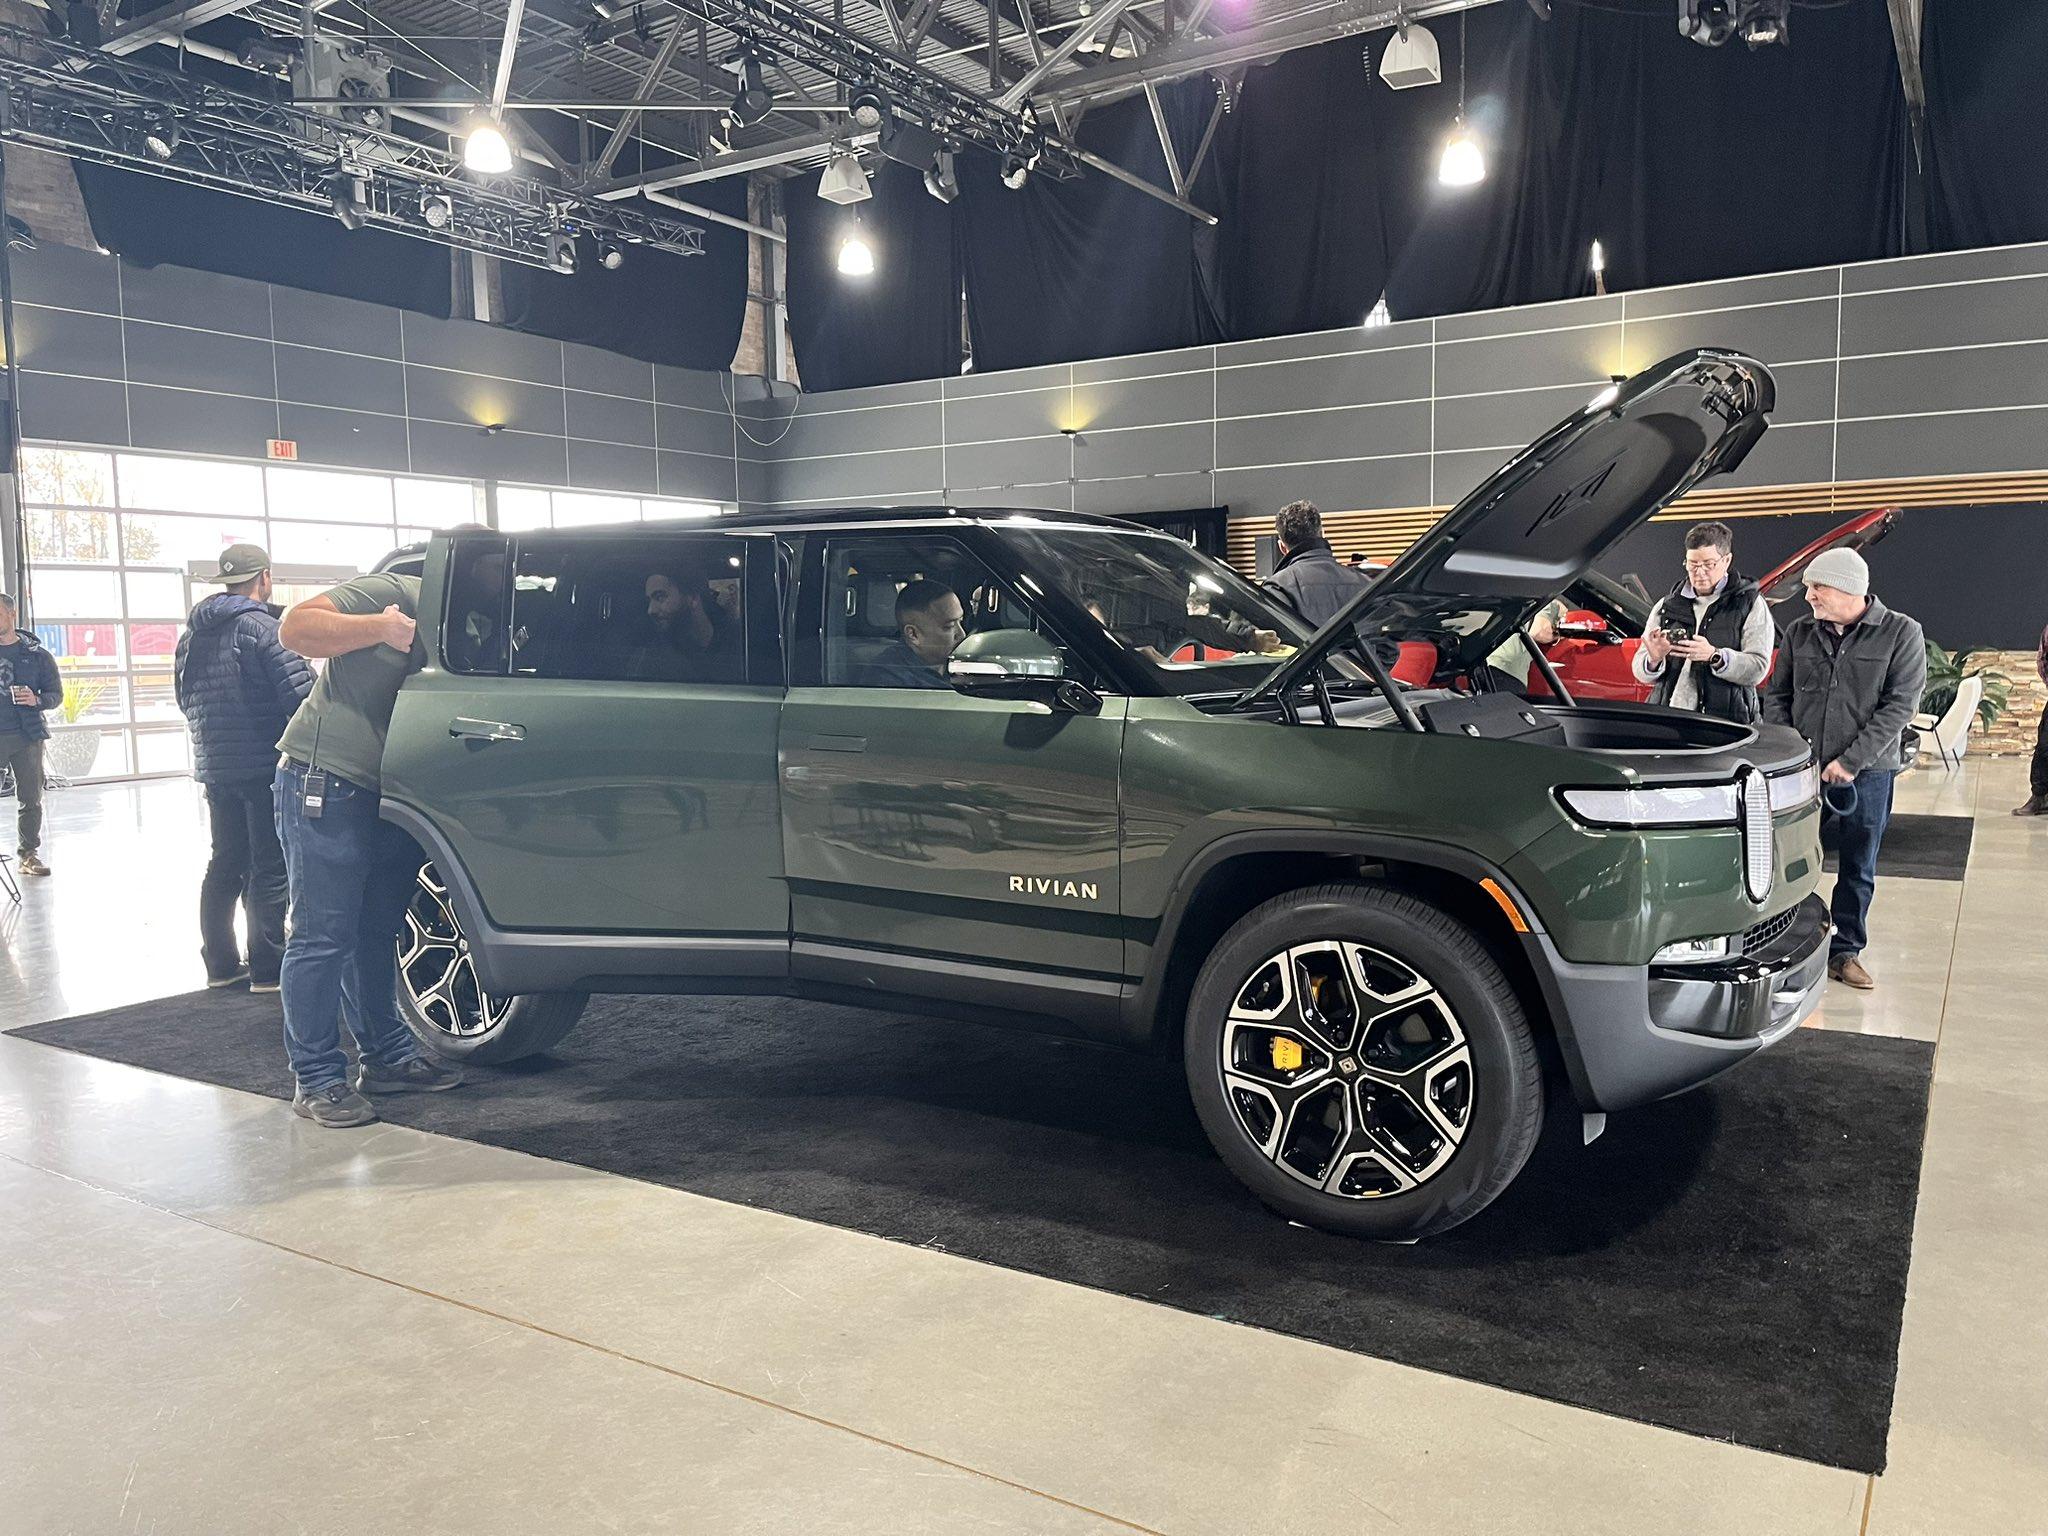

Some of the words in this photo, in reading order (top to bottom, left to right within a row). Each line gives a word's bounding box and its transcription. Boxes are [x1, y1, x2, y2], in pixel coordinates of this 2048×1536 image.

[274, 441, 293, 458] EXIT
[1009, 875, 1098, 900] RIVIAN
[1281, 1041, 1290, 1064] RIVI
